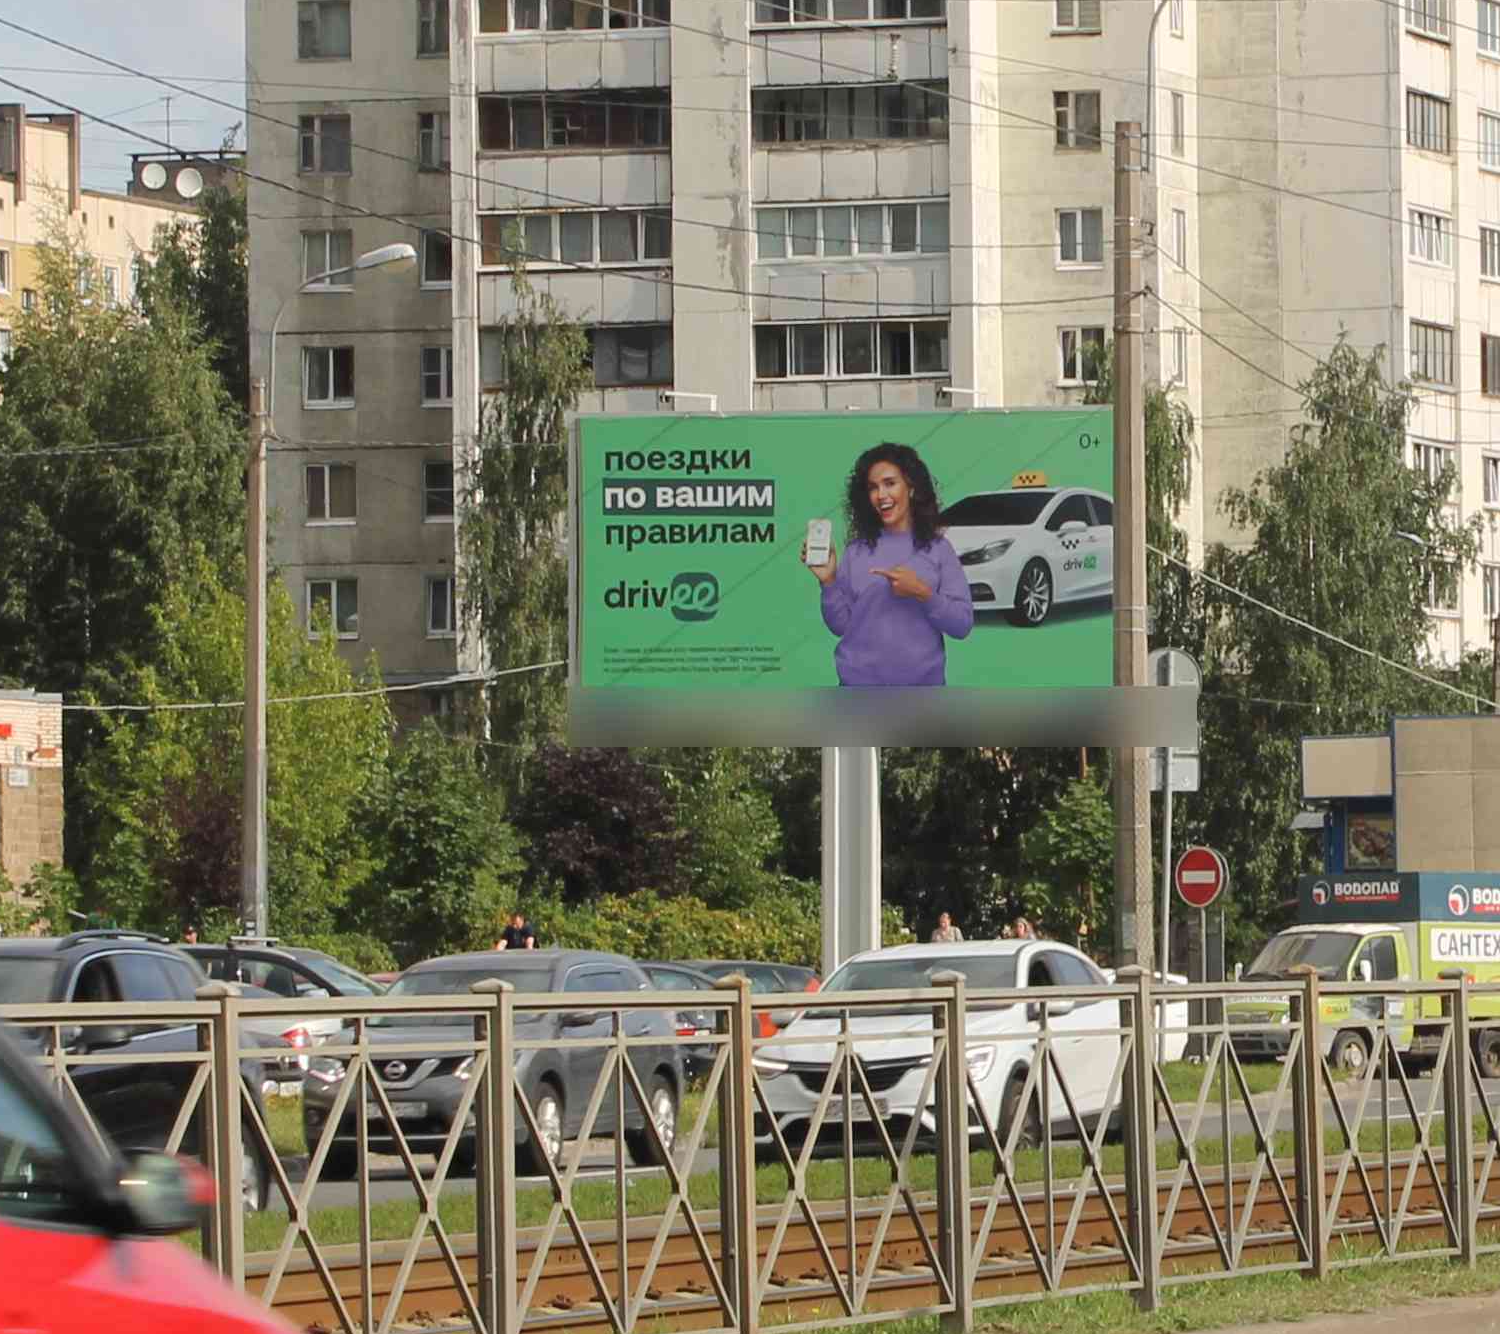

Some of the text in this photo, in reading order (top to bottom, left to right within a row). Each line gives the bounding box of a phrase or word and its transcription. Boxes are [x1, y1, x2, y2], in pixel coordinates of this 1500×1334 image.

[1079, 433, 1101, 450] 0+
[604, 448, 751, 475] поездки
[604, 485, 773, 509] по вашим
[605, 522, 775, 552] правилам
[603, 571, 719, 623] drivee
[1334, 881, 1399, 896] ВОДОПАД
